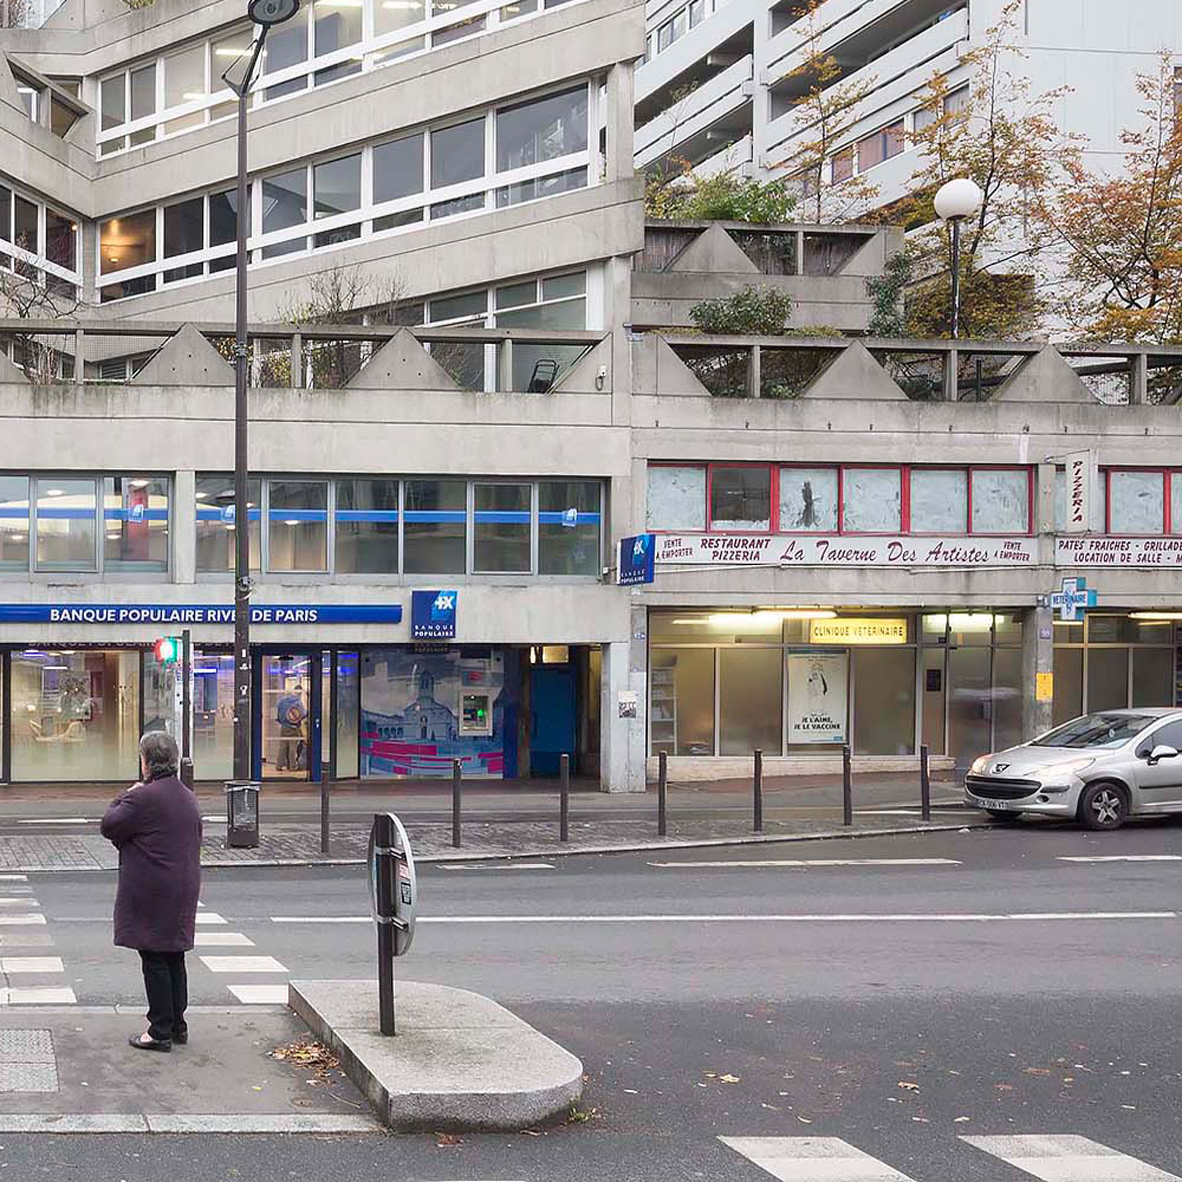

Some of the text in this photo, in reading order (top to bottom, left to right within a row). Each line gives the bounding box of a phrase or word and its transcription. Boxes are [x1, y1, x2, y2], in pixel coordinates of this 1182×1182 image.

[1072, 461, 1083, 522] PIZZERIA
[664, 538, 682, 548] VENTE
[700, 538, 771, 549] RESTAURANT
[1003, 541, 1021, 550] VENTE
[1089, 540, 1131, 551] FRAICHES
[662, 547, 693, 560] EMPORTER
[711, 550, 761, 561] PIZZERIA
[779, 540, 989, 563] La Taverne Des Artistes
[1074, 552, 1162, 563] LOCATION DE SALLE
[50, 609, 318, 623] BANQUE POPULAIRE RIVE DE PARIS
[813, 626, 849, 636] CLINIQUE
